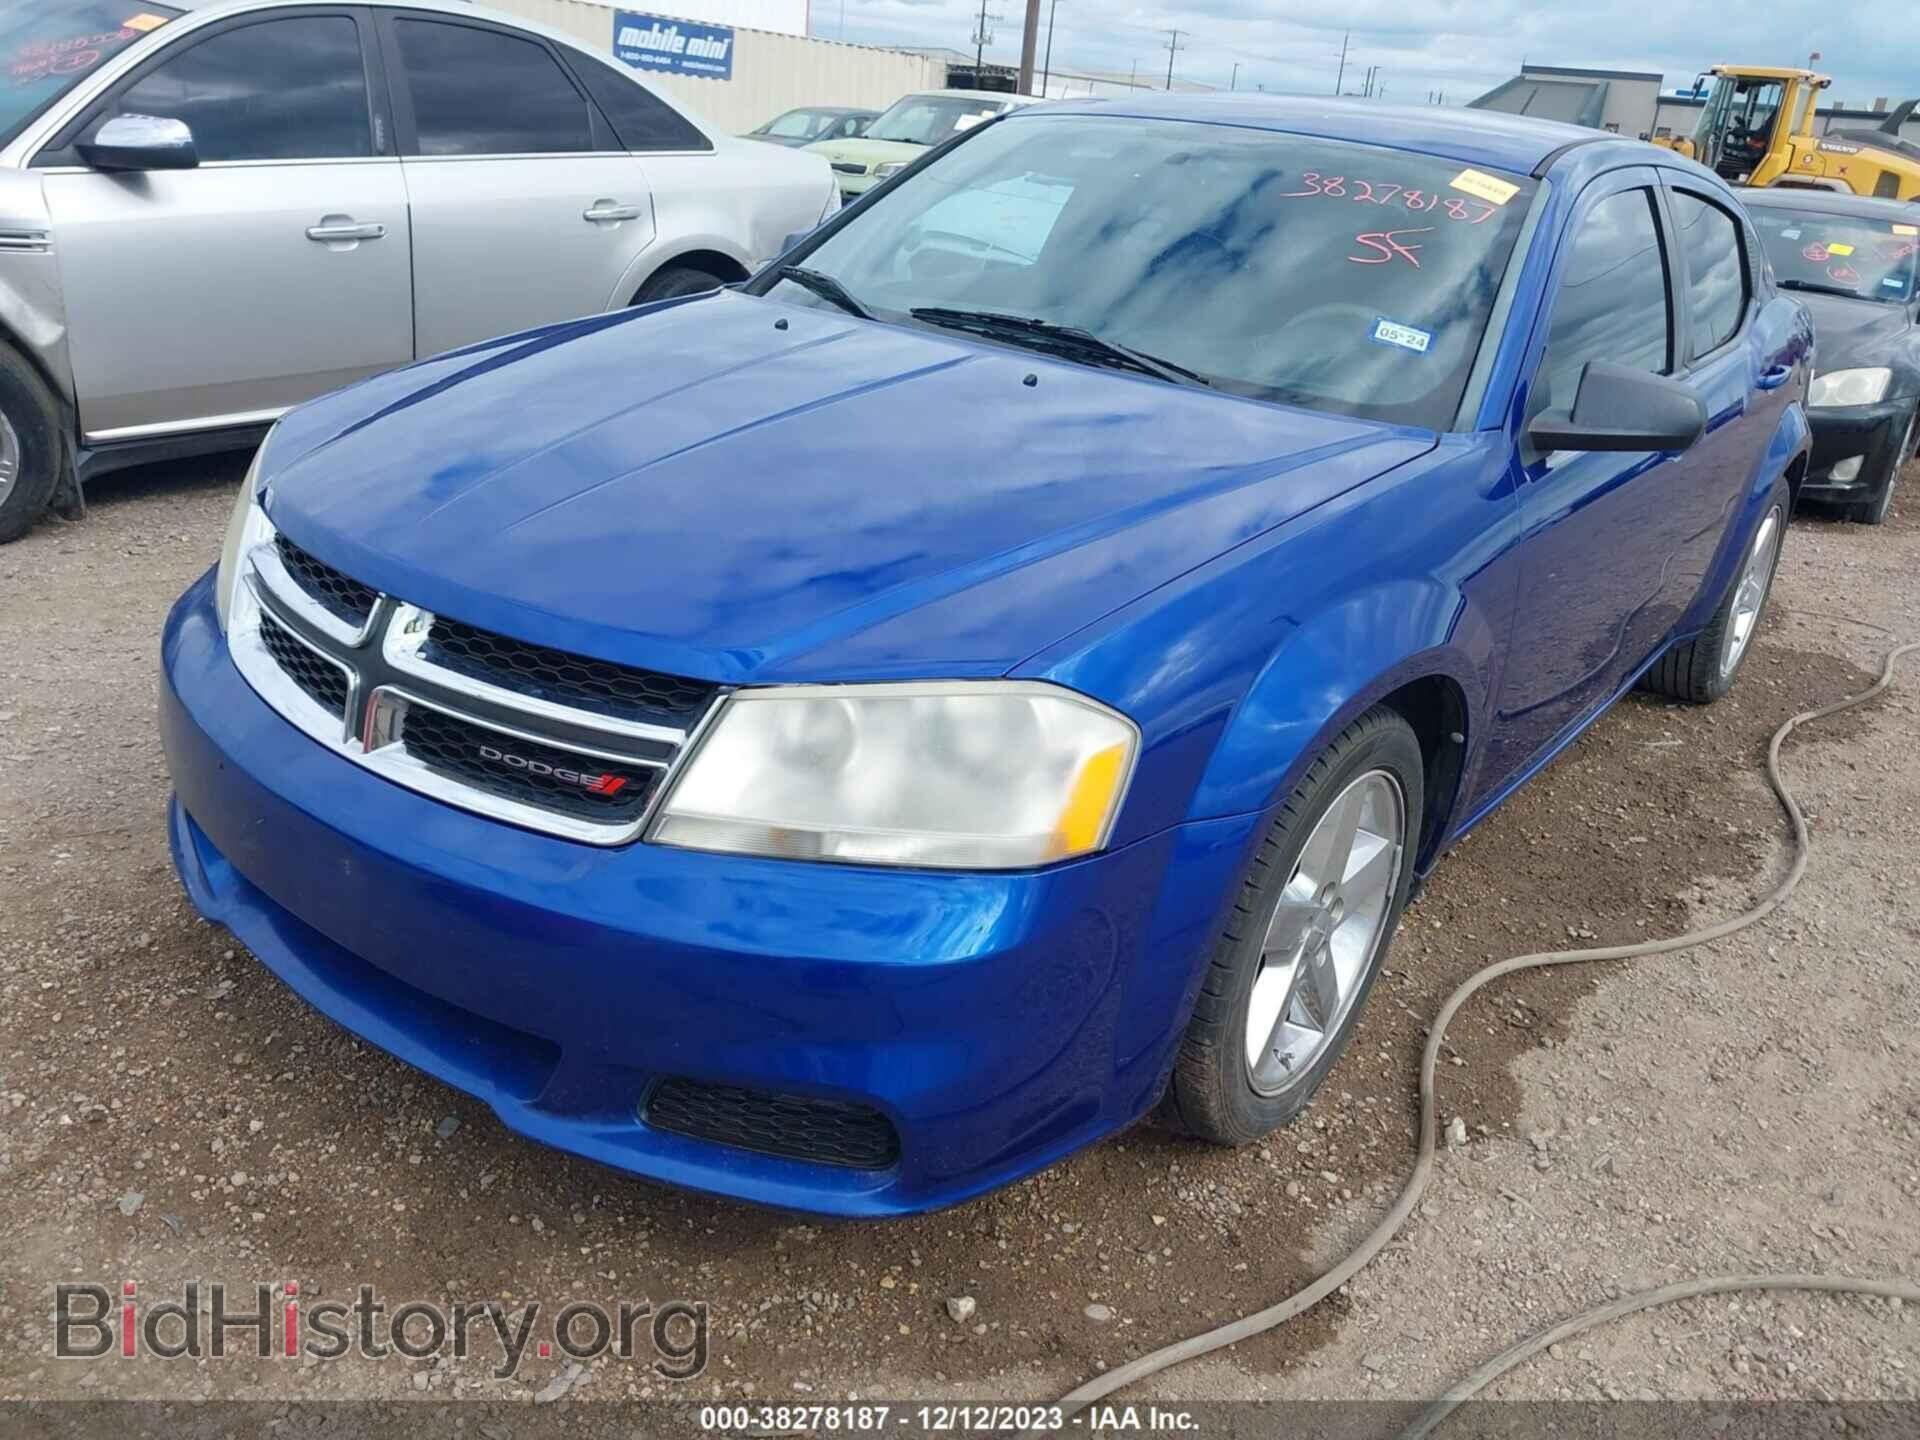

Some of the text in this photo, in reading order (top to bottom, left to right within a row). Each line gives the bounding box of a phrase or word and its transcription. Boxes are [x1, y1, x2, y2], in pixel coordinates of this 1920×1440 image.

[617, 23, 686, 53] mobile
[685, 36, 731, 60] mini
[1280, 172, 1496, 224] 38278187
[479, 745, 604, 789] DODGE
